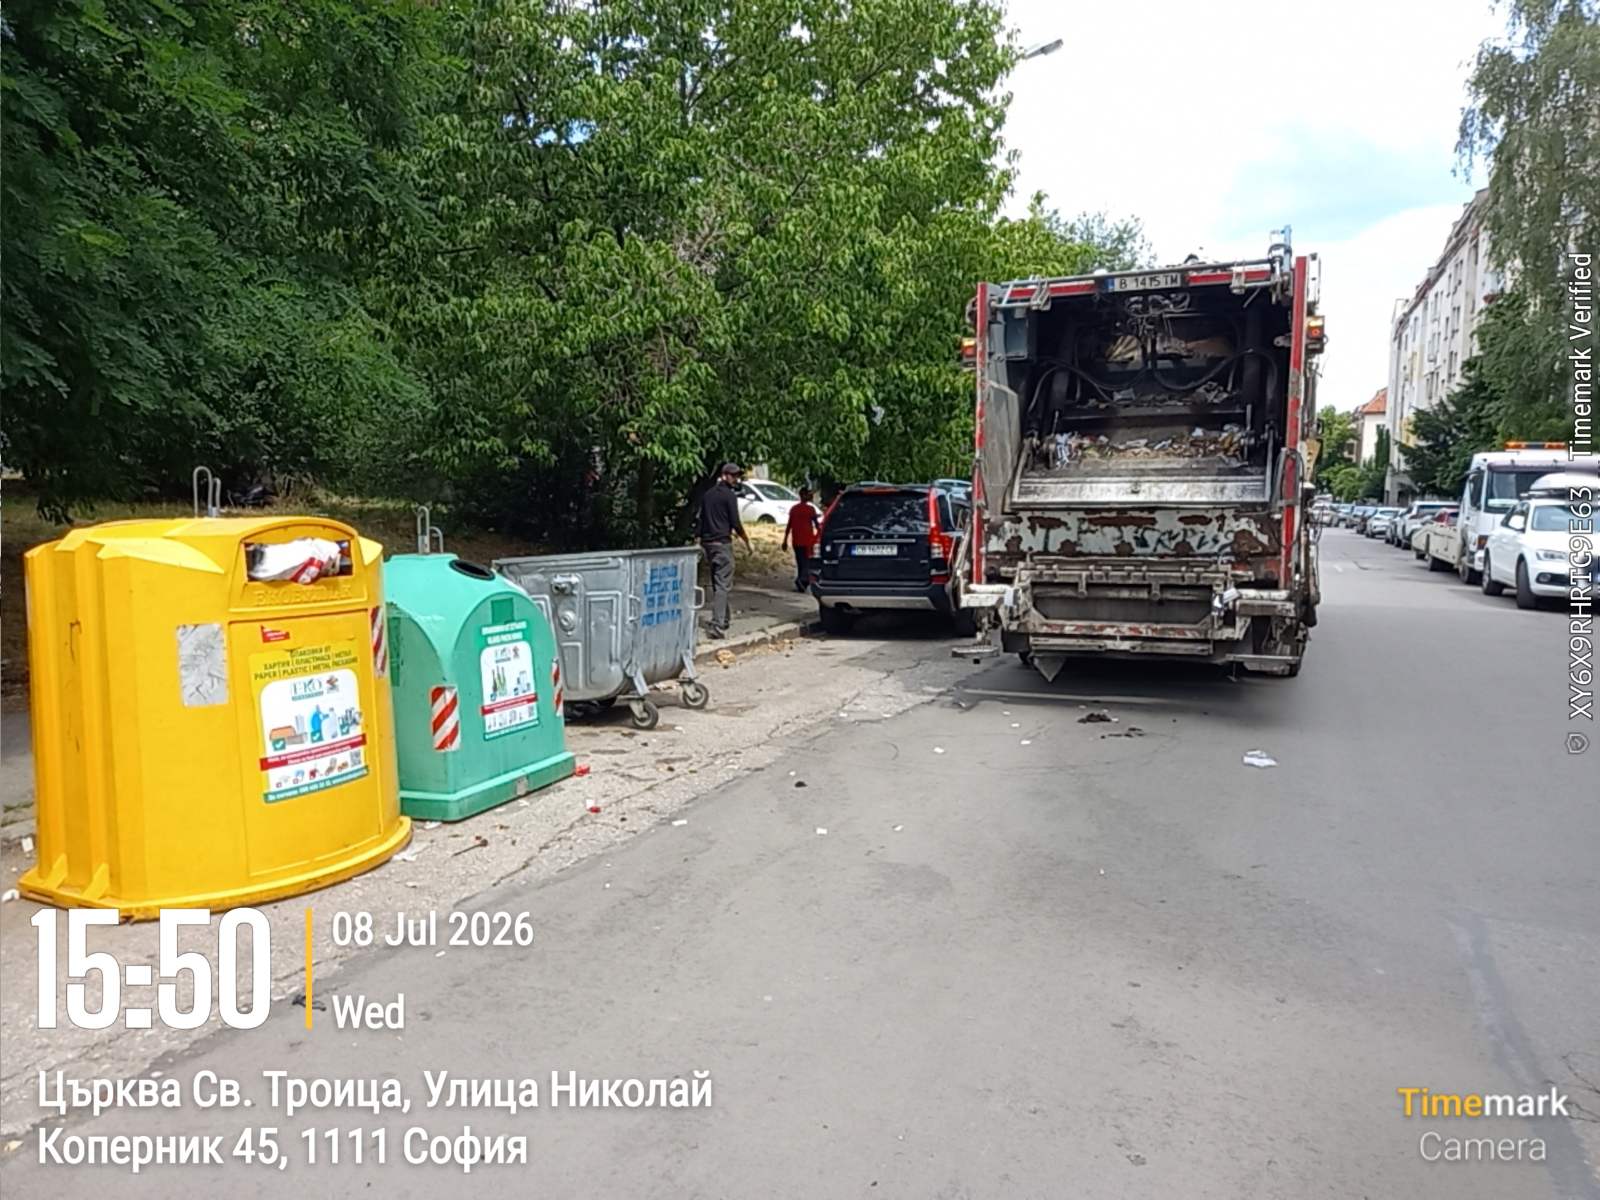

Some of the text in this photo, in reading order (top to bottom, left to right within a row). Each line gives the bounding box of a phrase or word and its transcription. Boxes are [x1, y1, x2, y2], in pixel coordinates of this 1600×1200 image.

[1120, 279, 1127, 289] B
[254, 671, 277, 680] PAPER
[283, 667, 308, 676] PLASTIC
